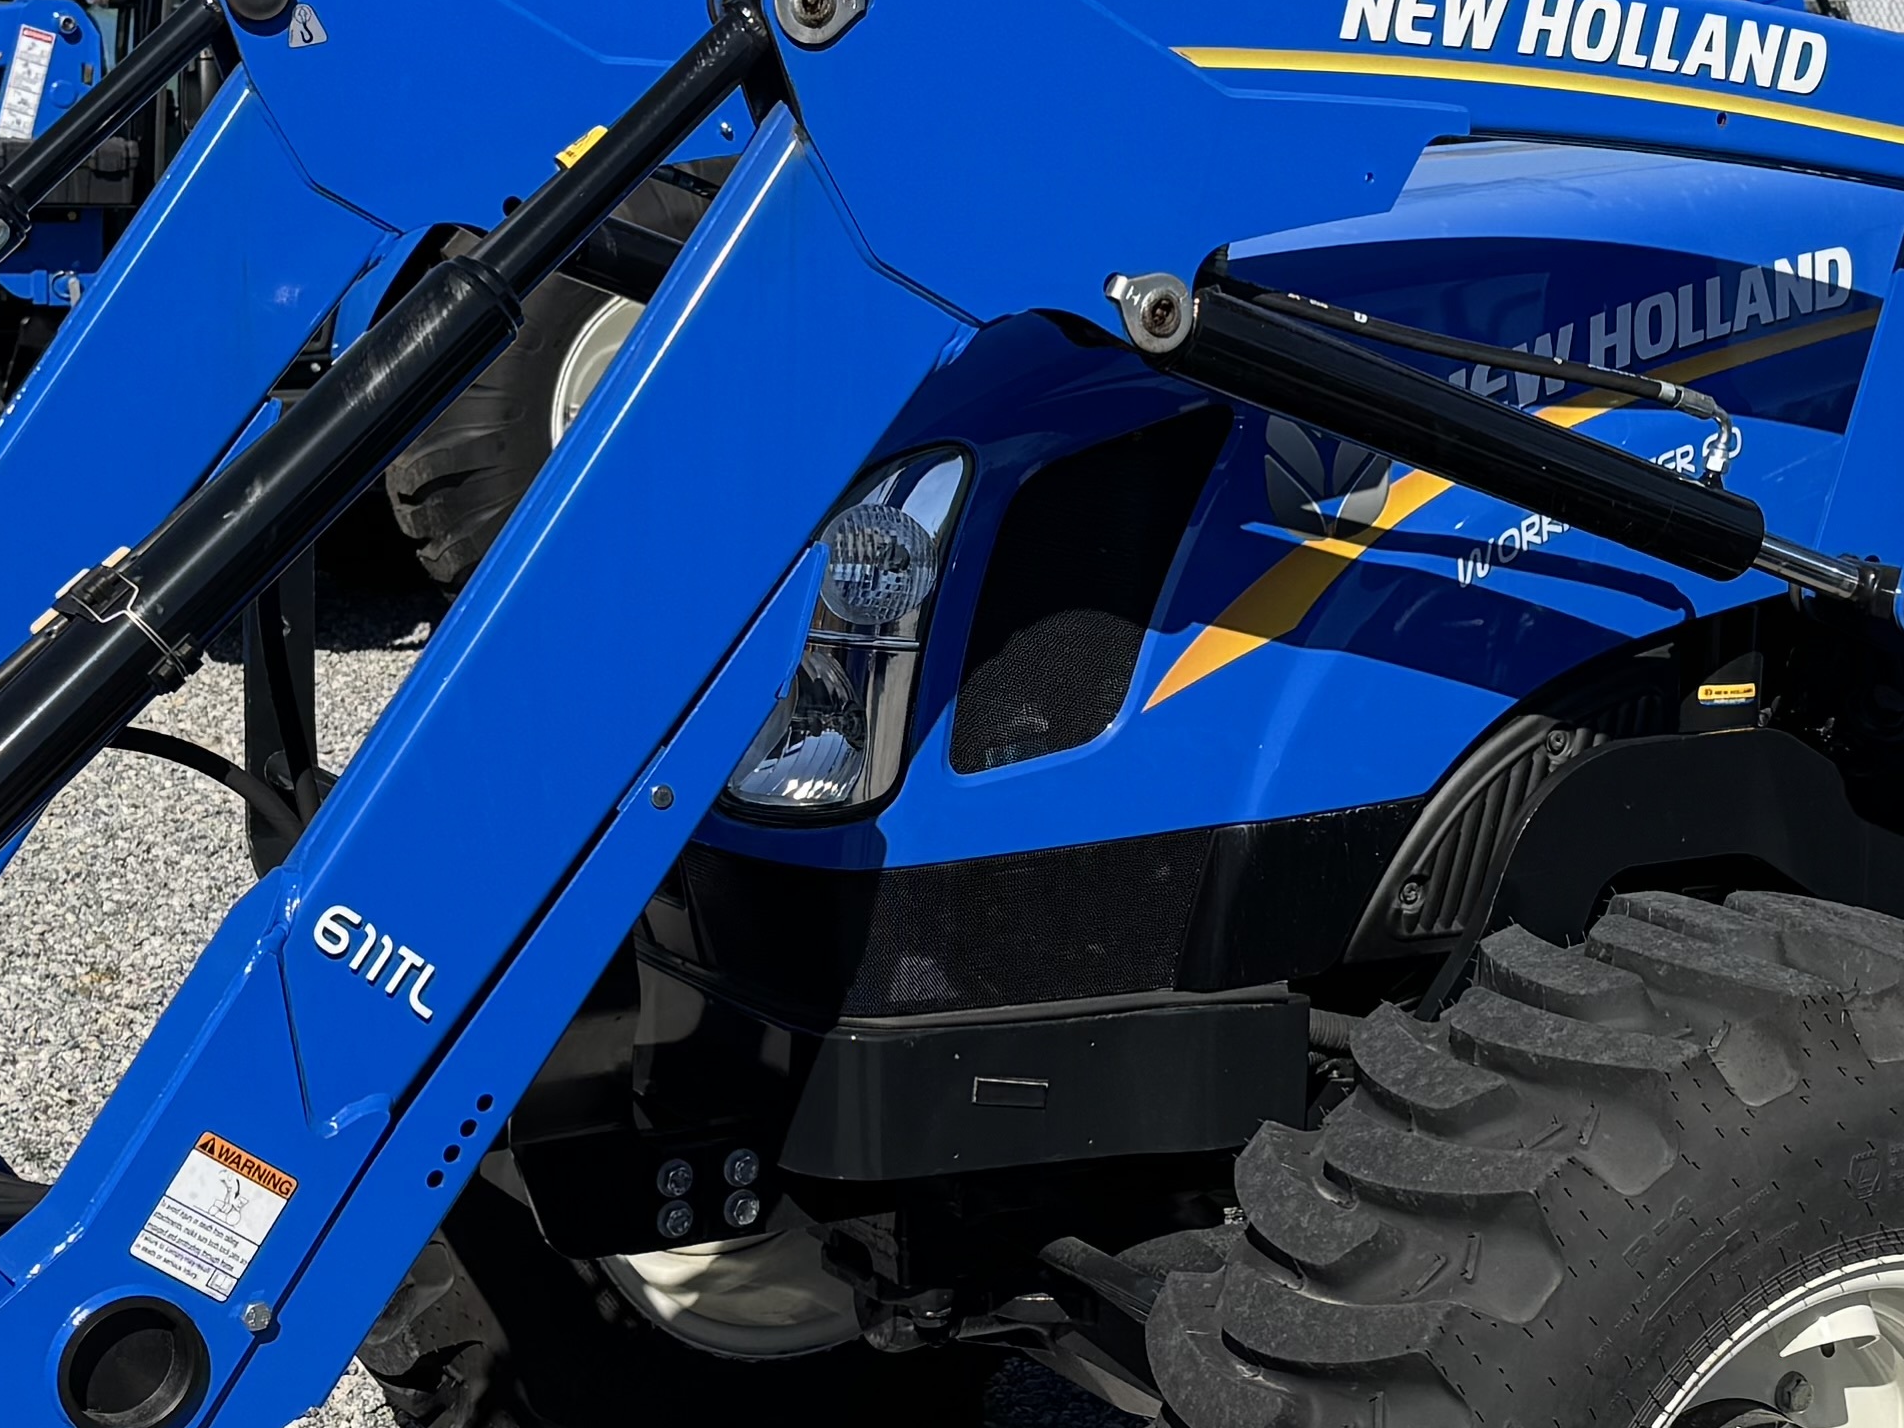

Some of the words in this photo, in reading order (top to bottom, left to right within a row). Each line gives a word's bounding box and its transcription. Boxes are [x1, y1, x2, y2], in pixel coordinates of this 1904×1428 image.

[1448, 323, 1574, 410] EW
[1589, 245, 1853, 370] HOLLAND
[313, 905, 436, 1020] 611TL
[217, 1143, 294, 1197] WARNING
